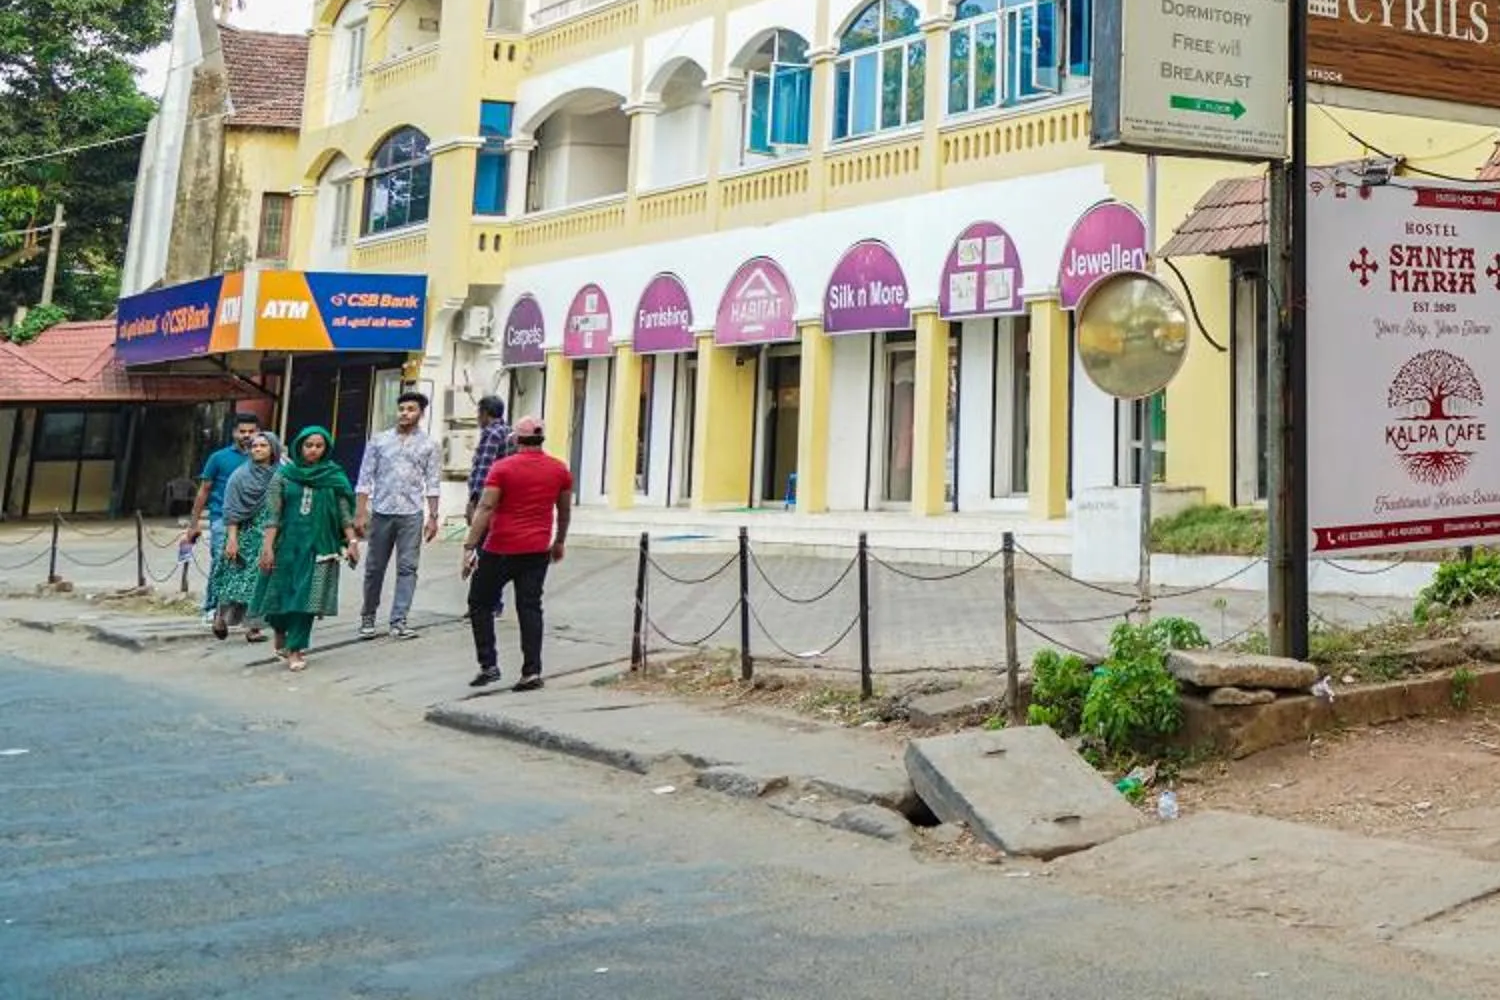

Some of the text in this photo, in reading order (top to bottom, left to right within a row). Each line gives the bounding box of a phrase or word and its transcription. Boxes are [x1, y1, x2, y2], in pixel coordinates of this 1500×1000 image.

[1160, 61, 1252, 89] BREAKFAST
[1405, 221, 1459, 238] HOSTEL
[1066, 243, 1145, 277] Jeweller
[1389, 244, 1476, 270] SANTA
[1389, 269, 1477, 294] MARIA
[347, 293, 420, 308] CSB Bank
[829, 283, 854, 310] Silk
[869, 280, 904, 305] More
[261, 300, 310, 320] ATM
[639, 307, 690, 332] Furnishing
[507, 325, 542, 353] Carpets
[1384, 423, 1487, 452] KALPA CAFE
